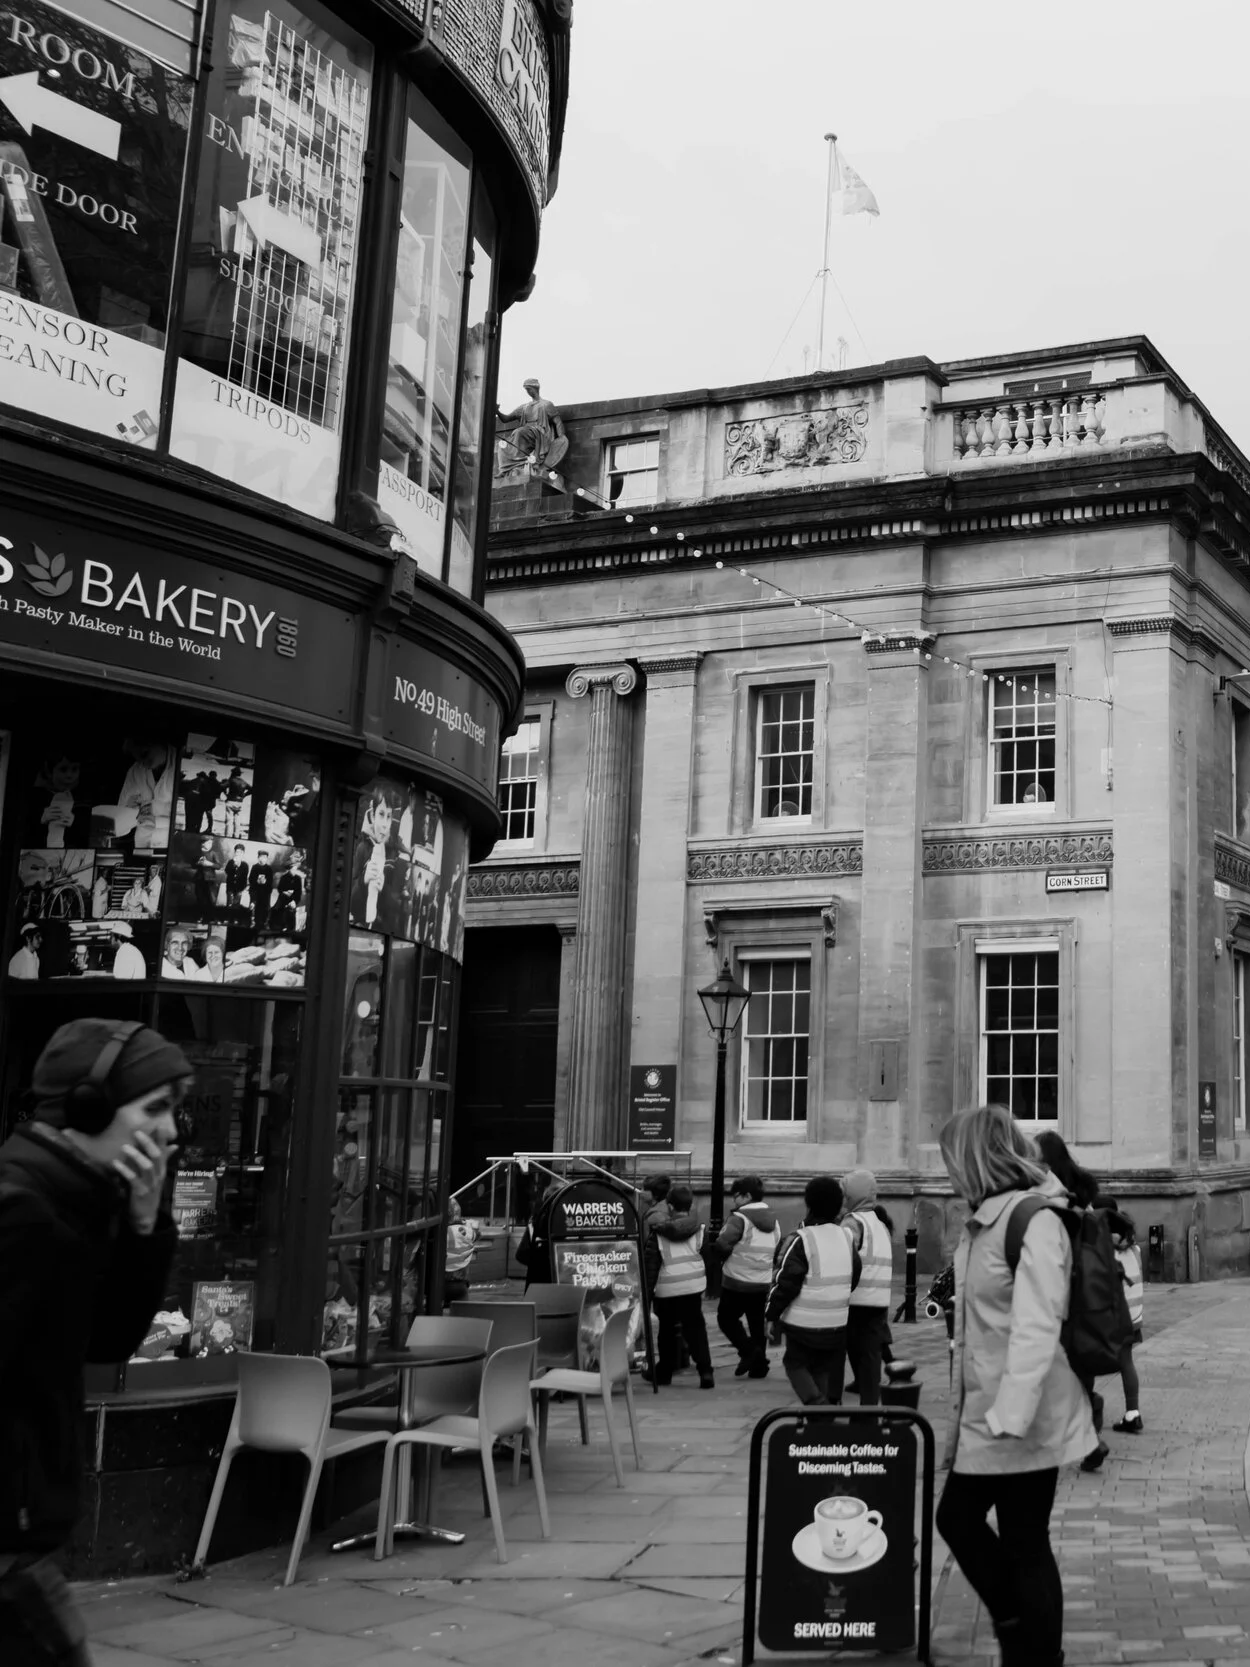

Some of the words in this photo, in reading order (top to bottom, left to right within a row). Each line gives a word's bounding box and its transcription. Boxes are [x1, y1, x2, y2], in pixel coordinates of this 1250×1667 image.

[7, 13, 136, 100] ROOM
[55, 183, 138, 235] DOOR
[210, 379, 311, 445] TRIPODS
[380, 464, 444, 521] ASSPORT
[80, 559, 276, 649] BAKERY
[14, 599, 64, 626] Pasty
[68, 610, 124, 636] Maker
[128, 625, 144, 642] in
[149, 630, 174, 648] the
[178, 637, 221, 660] World
[276, 616, 298, 659] 1860
[436, 696, 461, 731] High
[463, 712, 486, 748] Street
[1049, 877, 1072, 887] CORN
[1073, 875, 1104, 886] STREET
[563, 1202, 624, 1215] WARRENS
[575, 1214, 618, 1227] BAKERY
[563, 1250, 632, 1265] Firecracker
[576, 1262, 628, 1276] Chicken
[572, 1273, 611, 1289] Pasty
[202, 1285, 233, 1294] Santa's
[788, 1443, 848, 1457] Sustainable
[850, 1443, 883, 1457] Coffee
[884, 1444, 899, 1457] for
[798, 1461, 851, 1476] Discerning
[852, 1462, 887, 1475] Tastes.
[793, 1622, 842, 1638] SERVED
[843, 1621, 876, 1638] HERE
